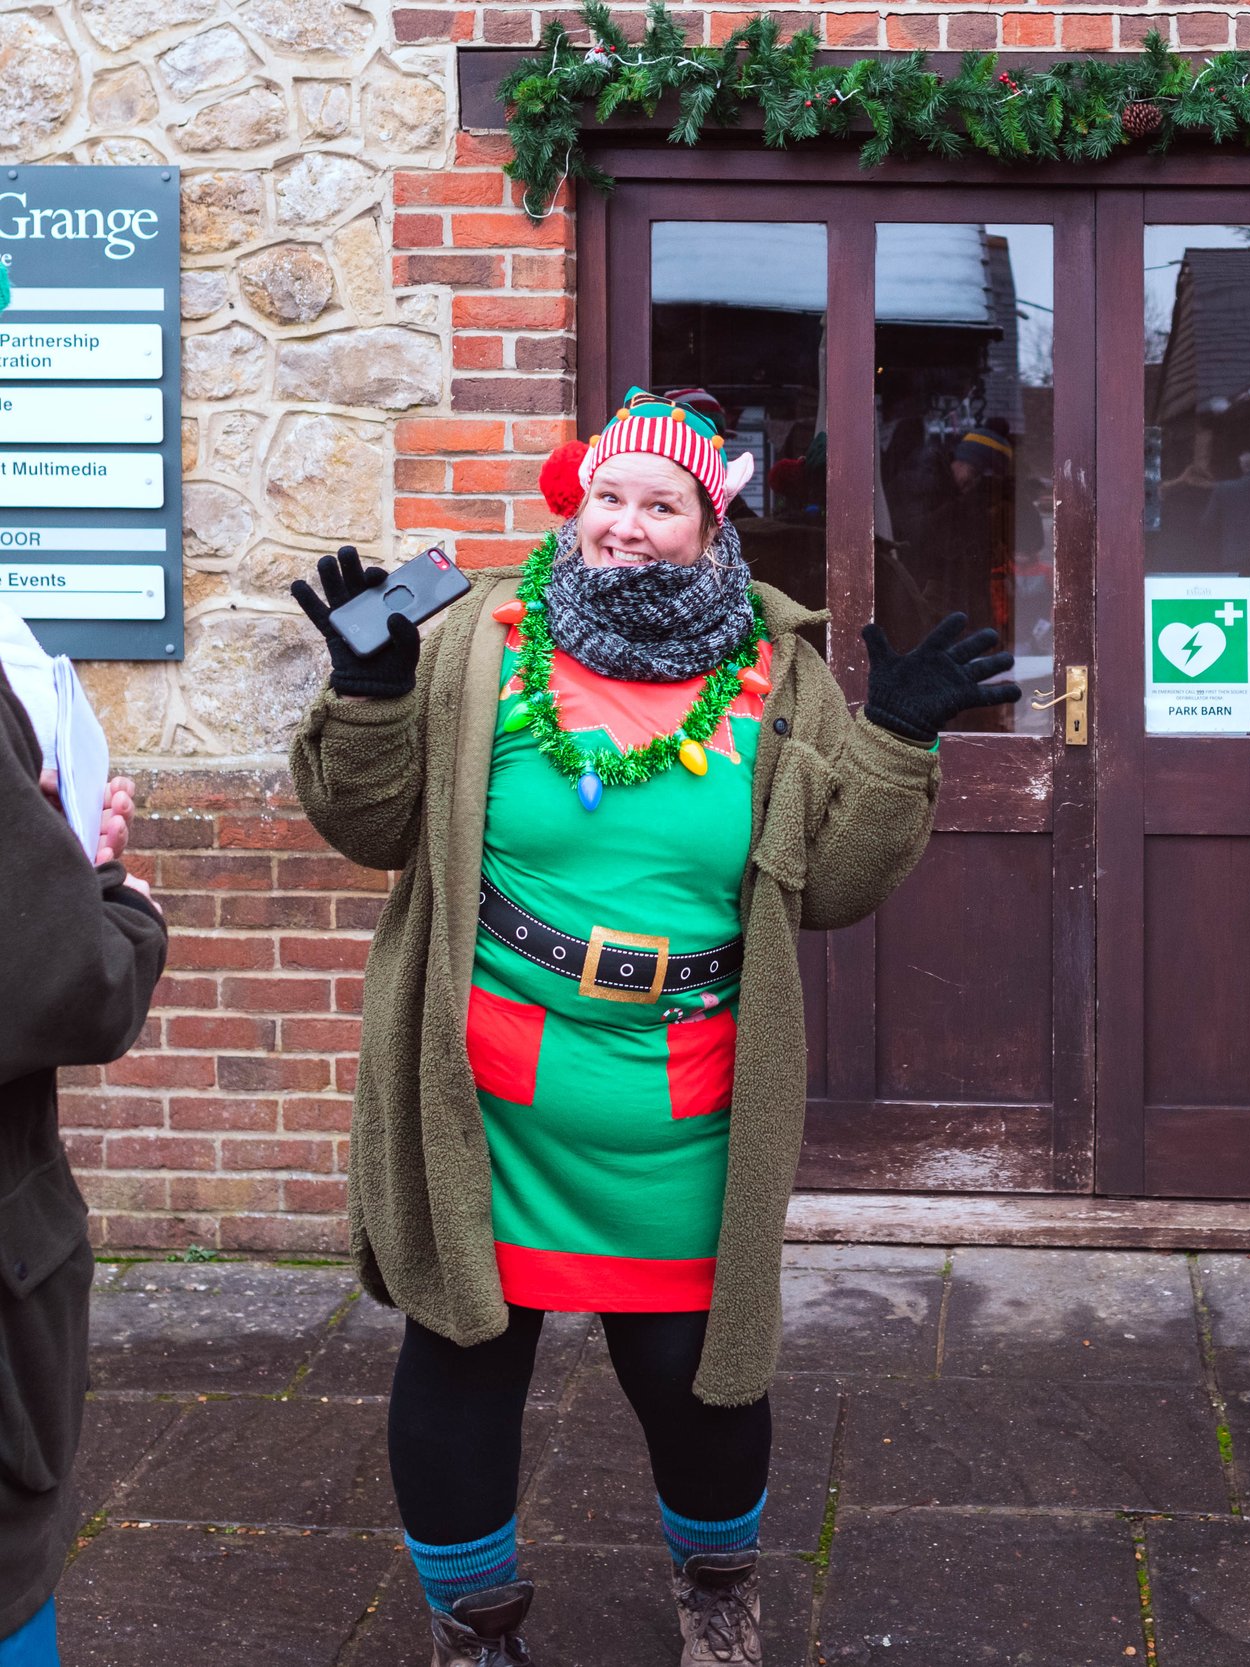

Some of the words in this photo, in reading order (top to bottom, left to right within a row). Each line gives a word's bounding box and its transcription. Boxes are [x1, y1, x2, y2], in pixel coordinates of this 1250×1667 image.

[0, 192, 159, 260] Grange
[0, 333, 100, 351] Partnership
[0, 354, 52, 367] ration
[13, 461, 107, 476] Multimedia
[8, 572, 66, 587] Events
[1168, 706, 1198, 716] PARK
[1201, 706, 1232, 716] BARN
